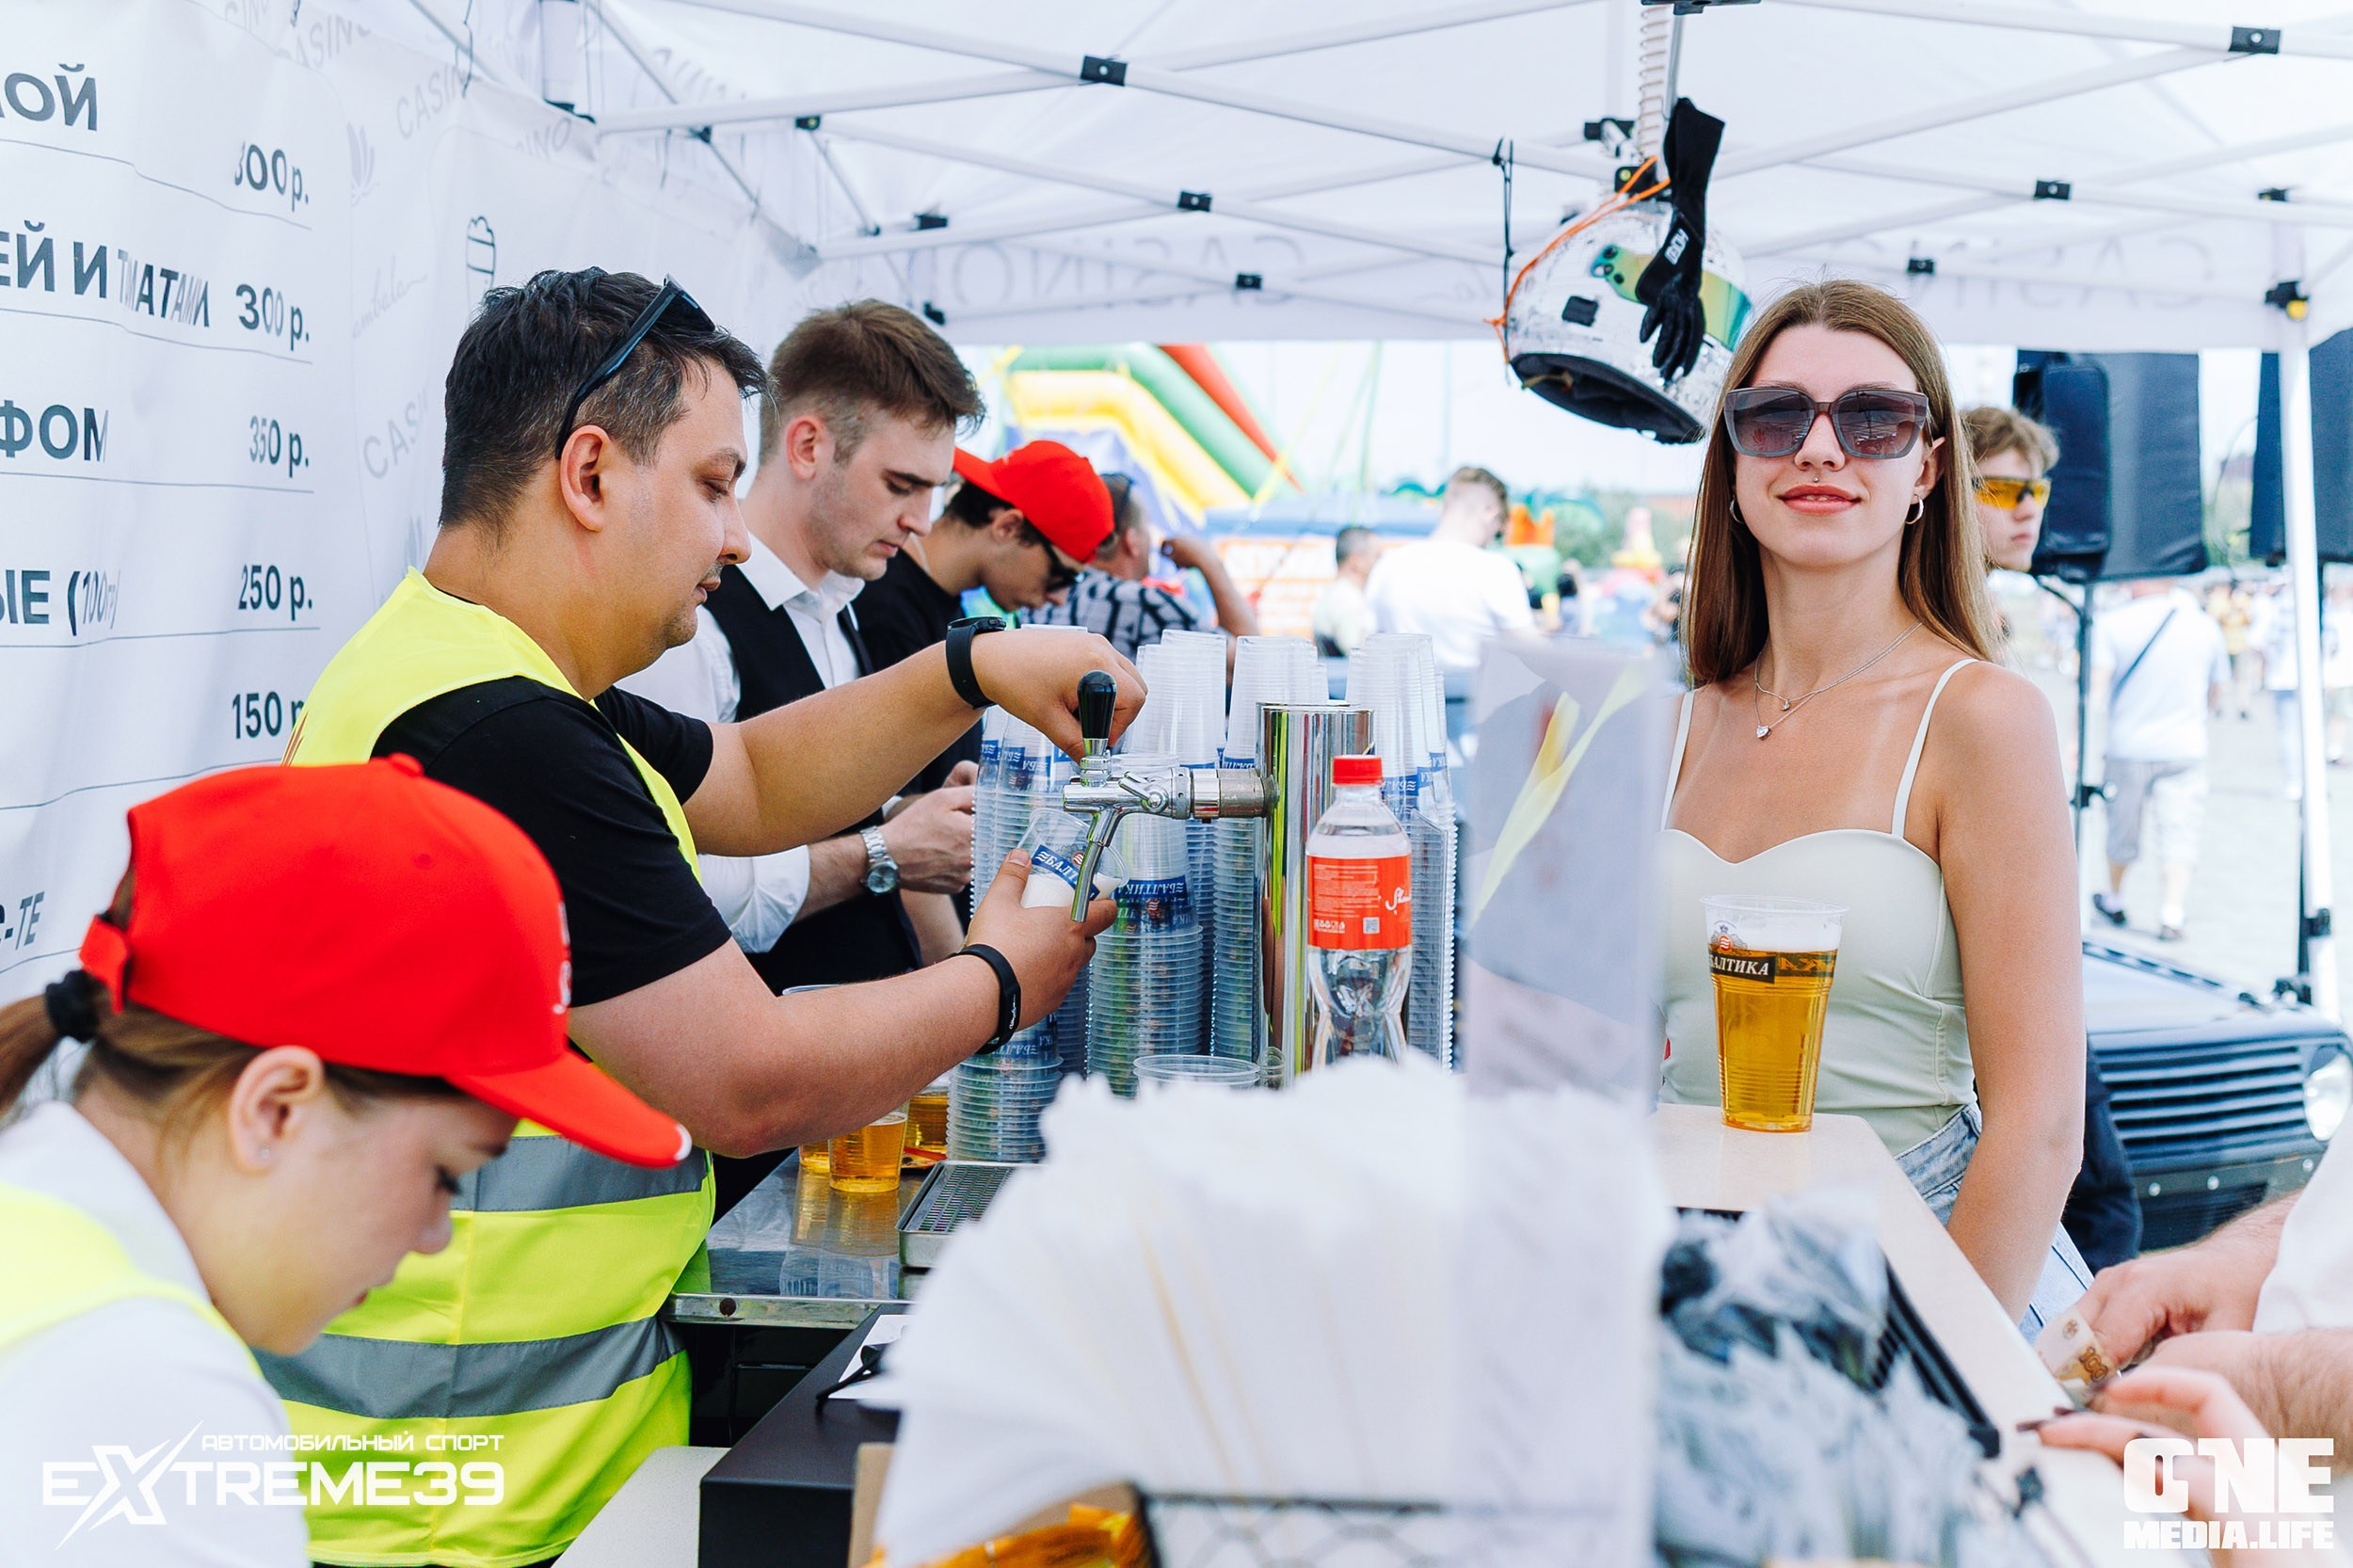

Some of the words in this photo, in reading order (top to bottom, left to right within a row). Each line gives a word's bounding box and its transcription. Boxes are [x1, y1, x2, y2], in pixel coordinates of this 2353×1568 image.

[0, 63, 97, 132] ОЙ
[397, 63, 483, 140] CASIN
[292, 165, 309, 213] р.
[73, 241, 107, 299] И
[236, 284, 284, 337] 300
[290, 305, 310, 352] р.
[249, 415, 280, 465] 350
[289, 432, 309, 477] р.
[238, 565, 281, 610] 250
[290, 576, 312, 621] р.
[232, 691, 282, 739] 150
[0, 891, 45, 951] -ТЕ
